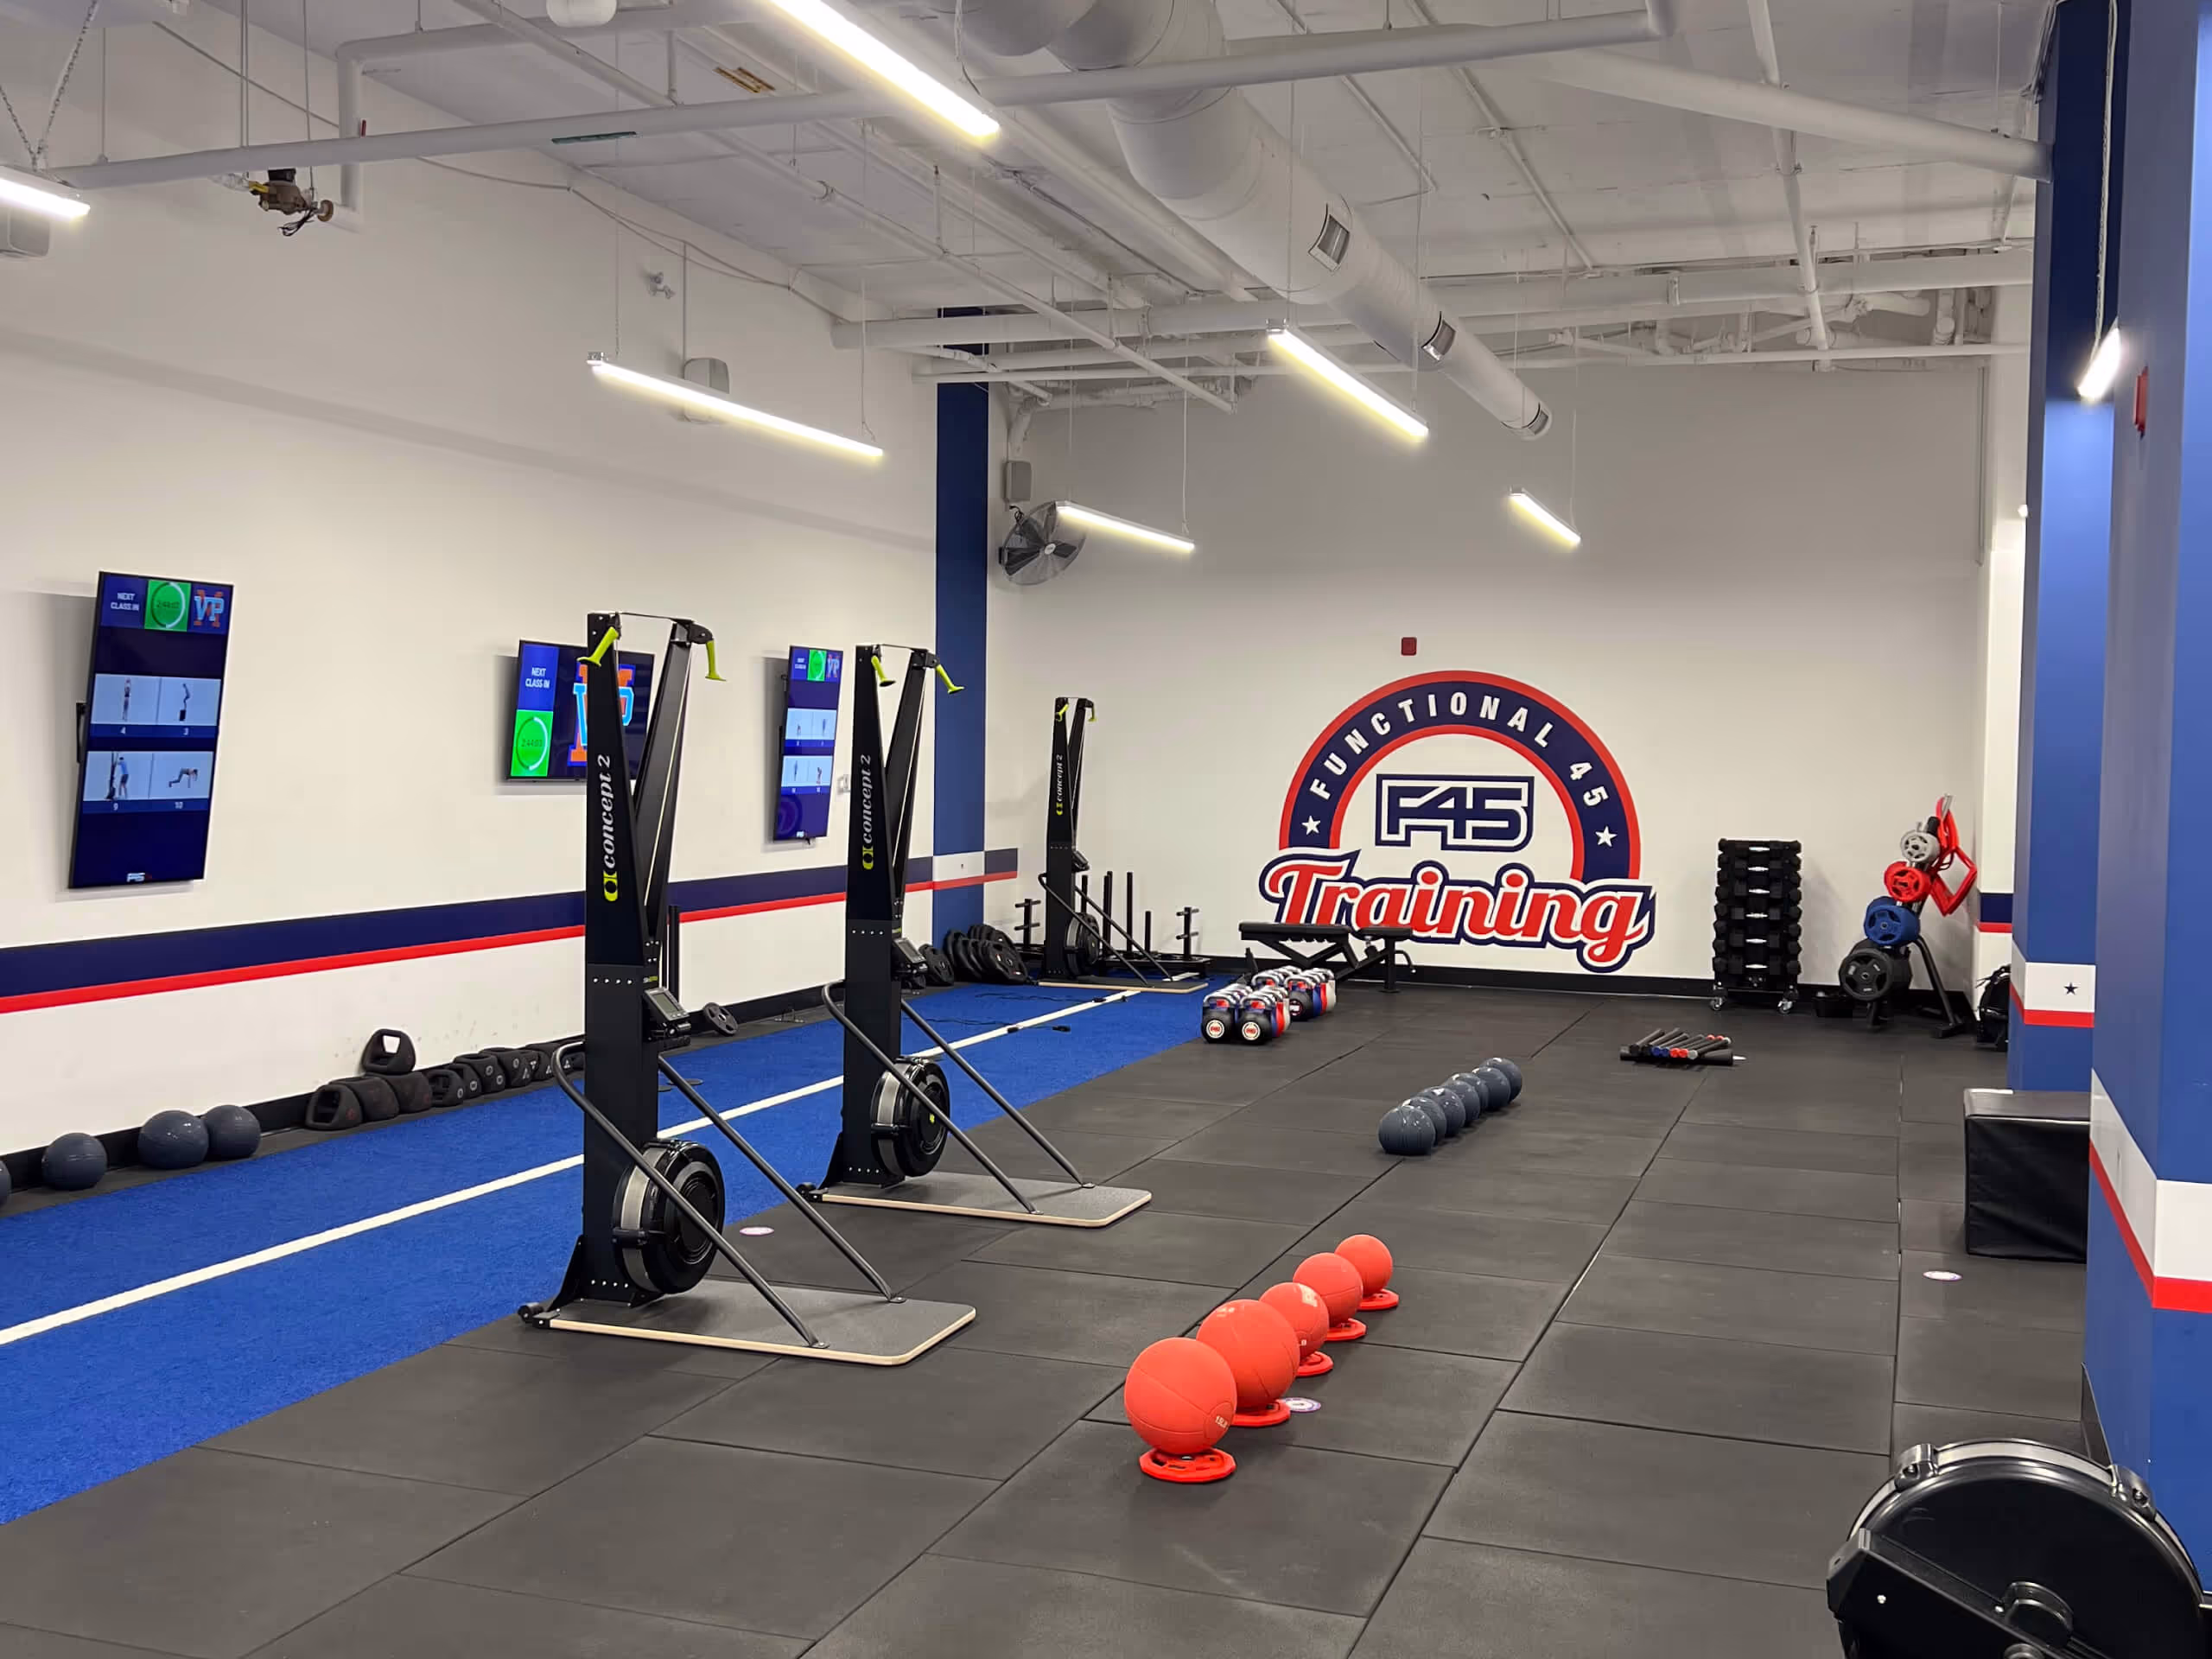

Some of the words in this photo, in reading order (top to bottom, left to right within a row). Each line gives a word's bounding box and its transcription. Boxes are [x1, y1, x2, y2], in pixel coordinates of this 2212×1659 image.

[524, 677, 543, 688] CLASS
[543, 679, 550, 689] IN
[531, 667, 546, 677] NEXT
[597, 753, 611, 768] 2
[860, 753, 871, 765] 2
[1309, 691, 1554, 800] FUNCTIONAL
[1569, 760, 1610, 807] 45
[599, 772, 616, 869] concept
[861, 768, 874, 844] concept
[1381, 779, 1531, 845] F45
[1262, 854, 1652, 967] Training
